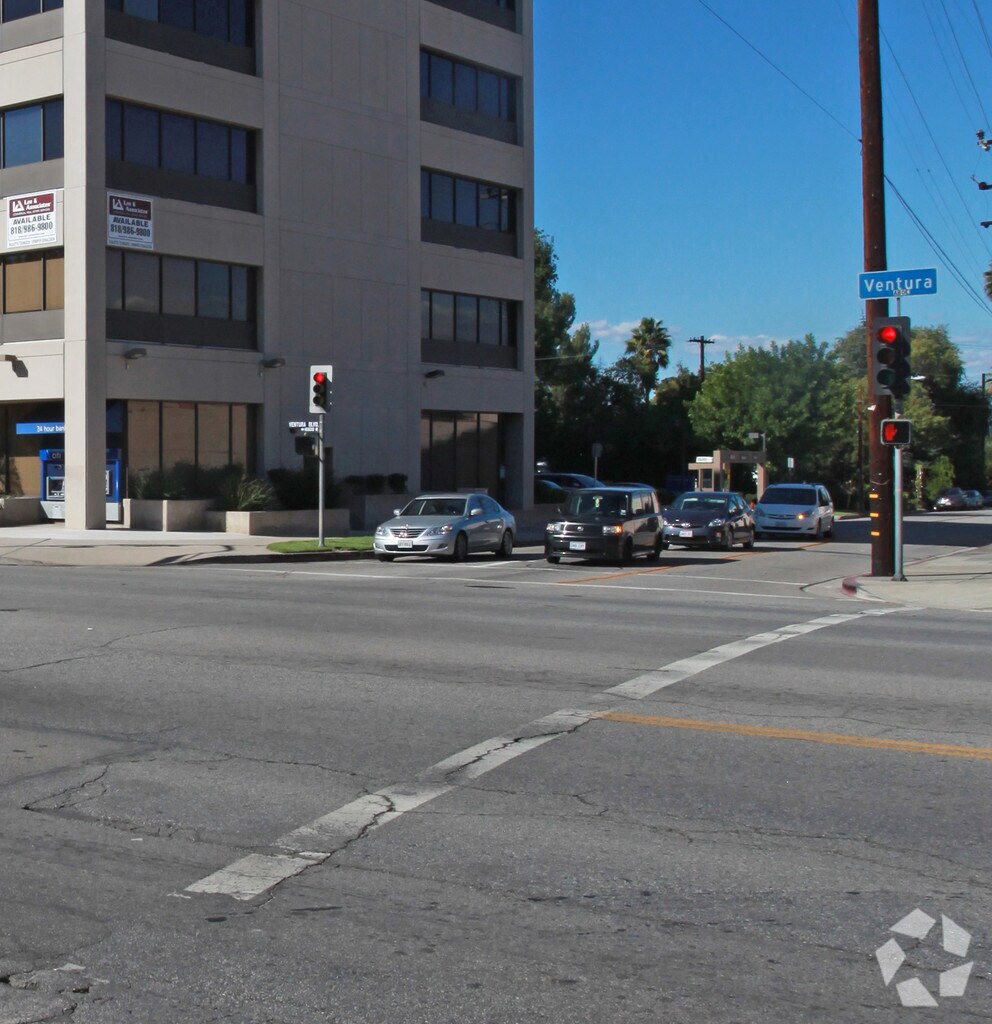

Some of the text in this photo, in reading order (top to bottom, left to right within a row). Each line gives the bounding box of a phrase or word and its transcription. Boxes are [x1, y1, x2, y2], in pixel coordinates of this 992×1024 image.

[13, 213, 51, 225] AVAILABLE
[113, 216, 149, 228] AVAILABLE
[10, 221, 54, 235] 818/986-9800
[110, 223, 151, 238] 818/986-9800
[864, 277, 933, 292] Ventura
